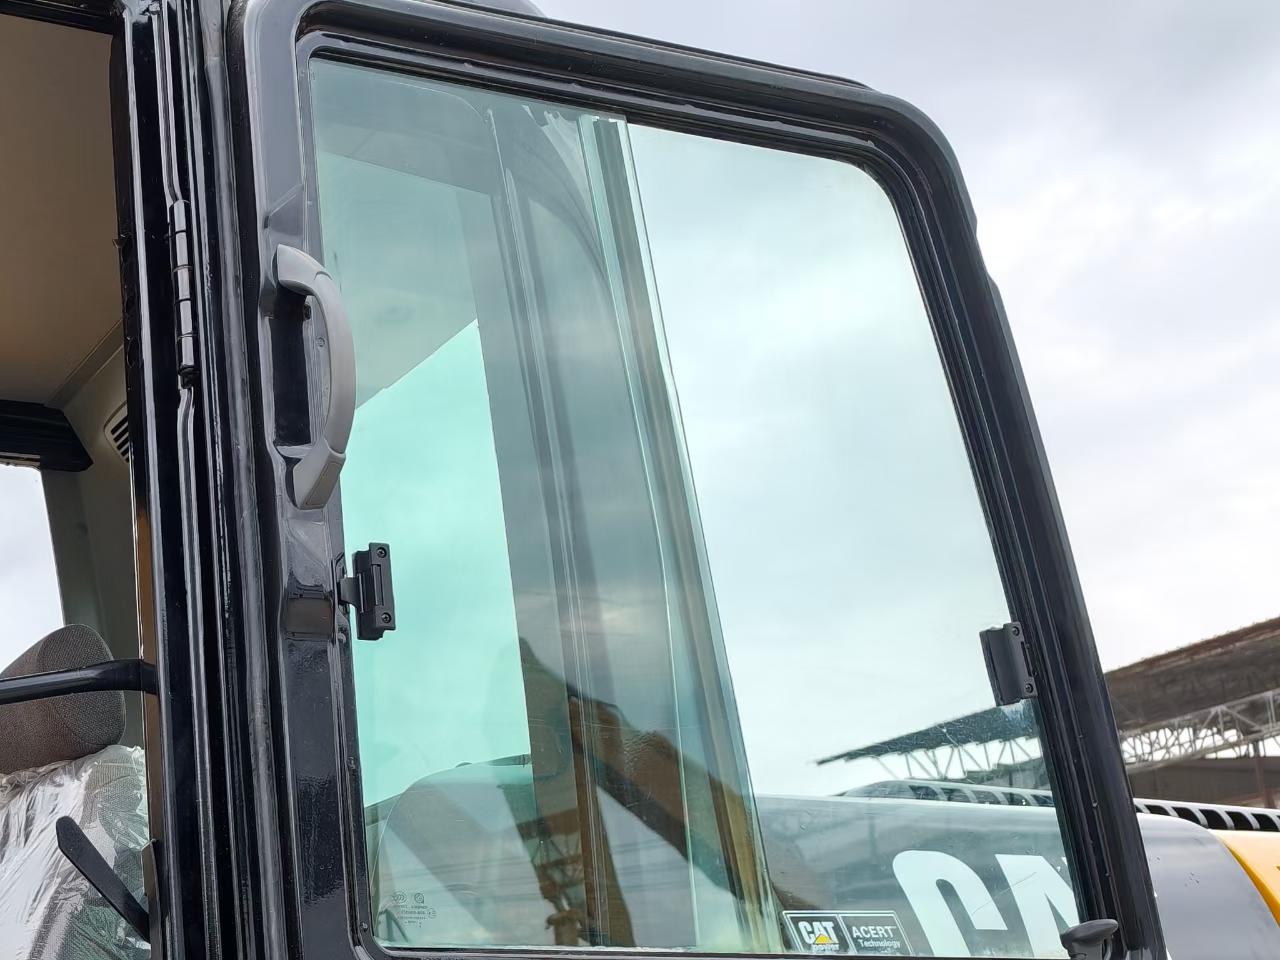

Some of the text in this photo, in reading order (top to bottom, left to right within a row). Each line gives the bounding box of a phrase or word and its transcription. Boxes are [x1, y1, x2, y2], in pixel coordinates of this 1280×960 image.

[798, 921, 839, 945] CAT
[852, 925, 896, 938] ACERT
[857, 939, 901, 949] Technology
